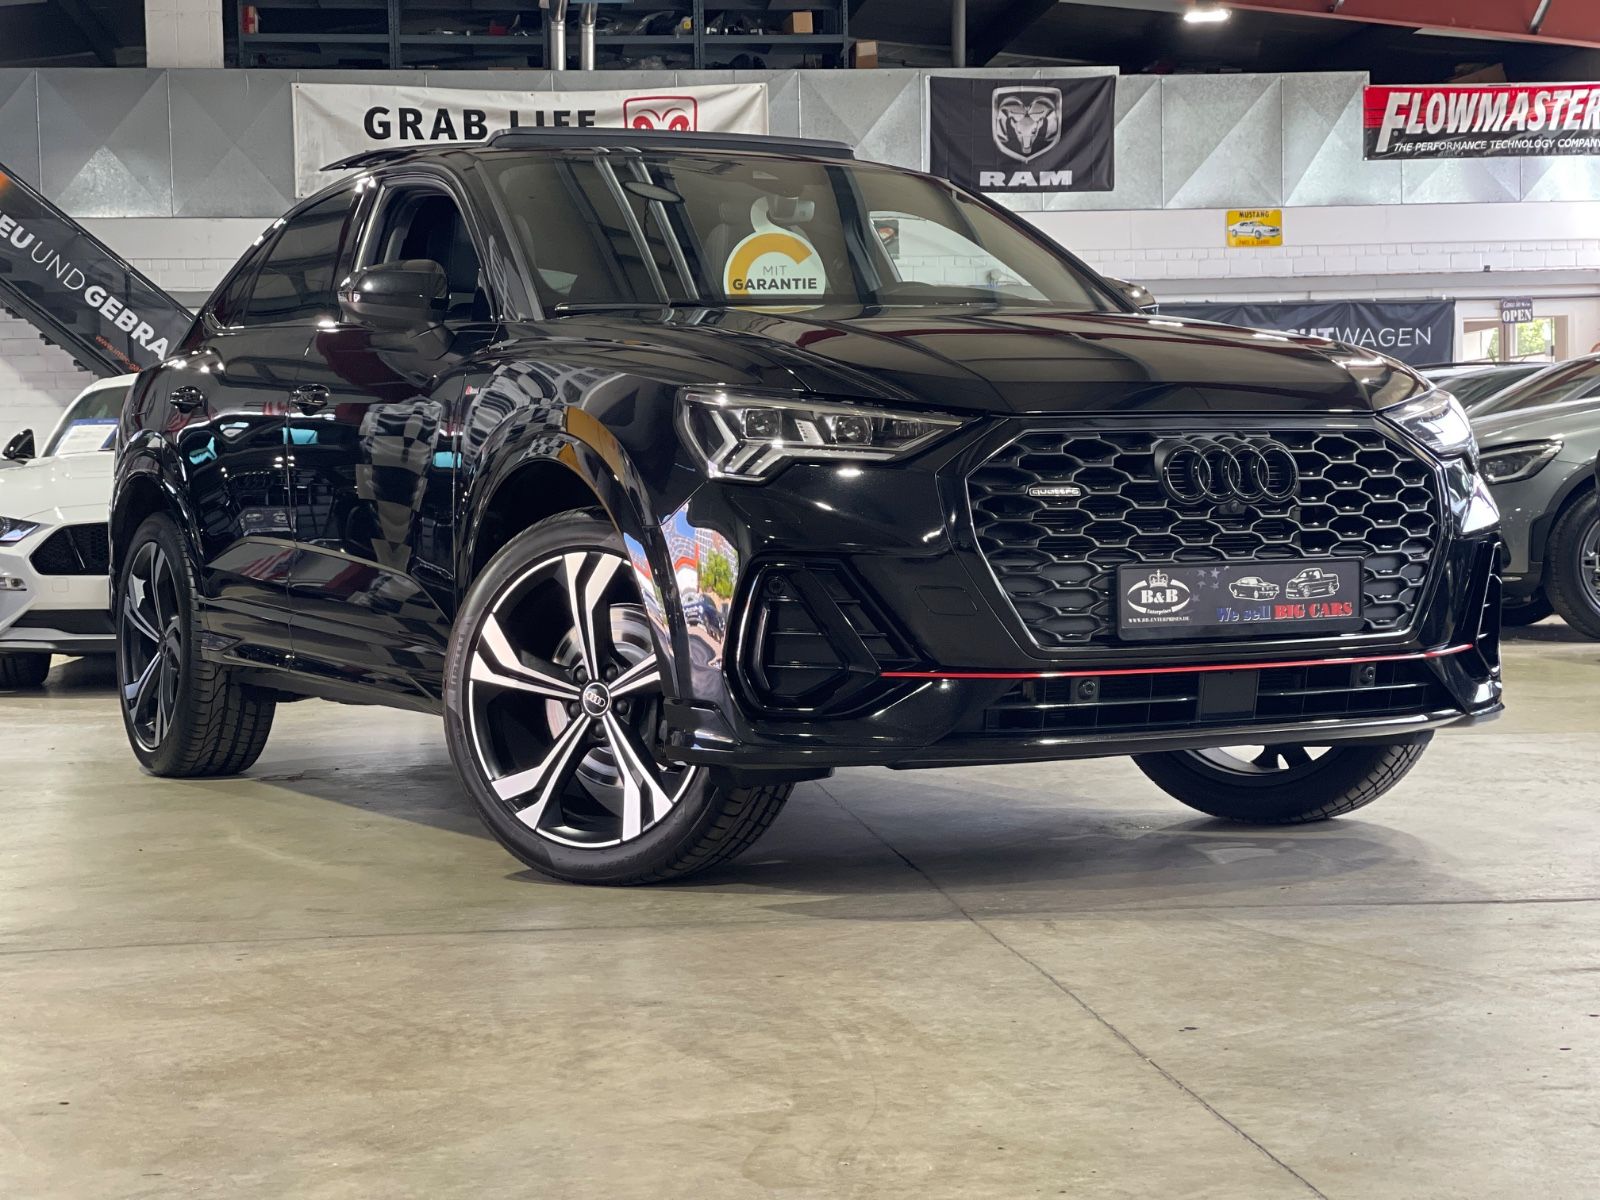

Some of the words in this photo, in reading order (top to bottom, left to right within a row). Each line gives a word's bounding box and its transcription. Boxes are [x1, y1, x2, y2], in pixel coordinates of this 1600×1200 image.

[364, 106, 488, 140] GRAB
[1375, 88, 1600, 152] FLOWMASTER
[1394, 142, 1413, 151] THE
[1415, 141, 1487, 151] PERFORMANCE
[1490, 139, 1555, 149] TECHNOLOGY
[1557, 137, 1600, 148] COMPANY
[979, 170, 1073, 187] RAM
[1238, 210, 1270, 218] MUSTANG
[762, 265, 787, 276] MIT
[732, 278, 818, 290] GARANTIE
[1502, 309, 1532, 322] OPEN
[1032, 488, 1079, 496] quattro
[1141, 589, 1178, 604] B&B
[1216, 607, 1239, 622] We
[1243, 604, 1271, 621] sell
[1274, 604, 1305, 619] BIG
[1309, 602, 1352, 618] CARS
